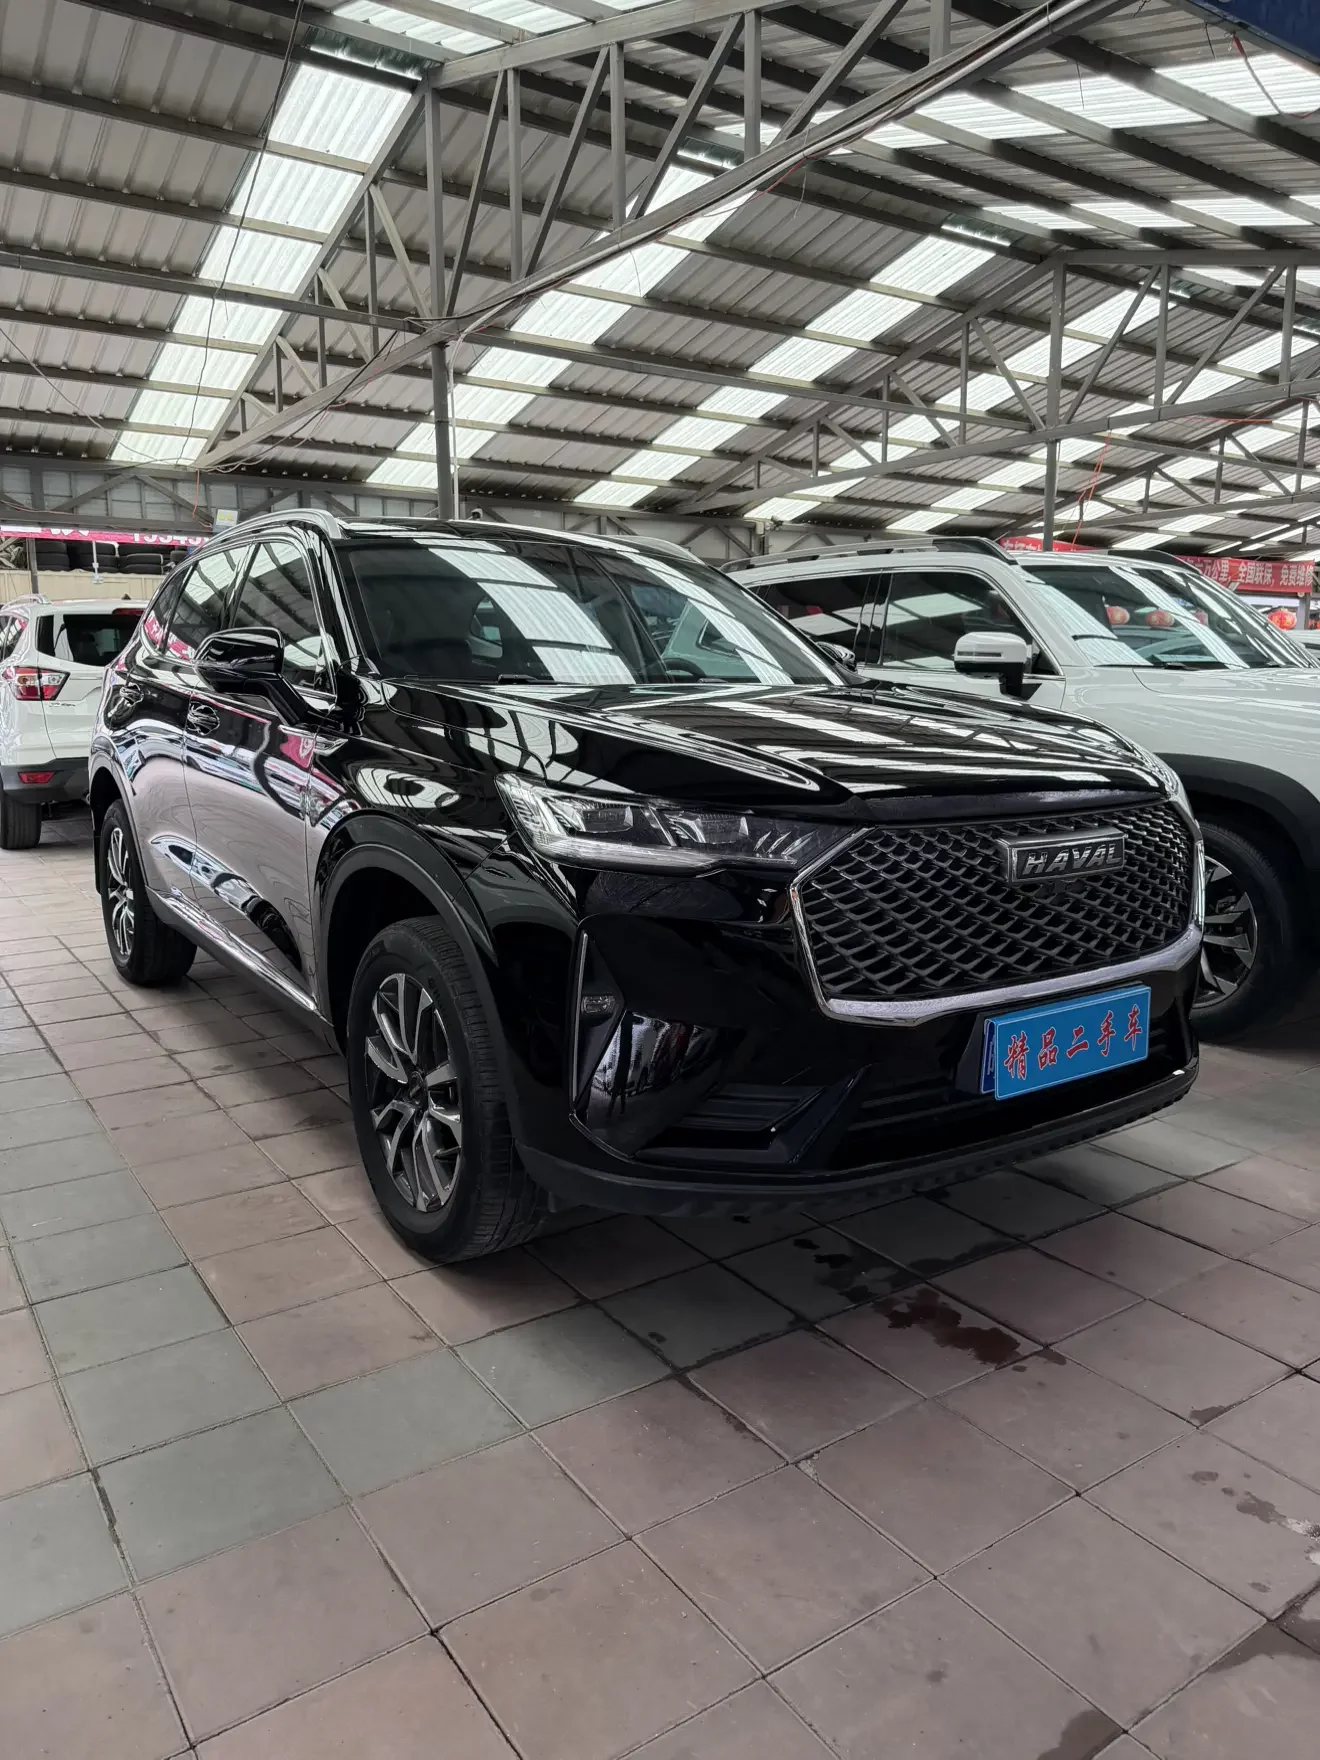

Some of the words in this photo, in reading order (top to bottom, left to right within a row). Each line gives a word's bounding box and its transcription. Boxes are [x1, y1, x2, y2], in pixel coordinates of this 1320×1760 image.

[1021, 843, 1122, 875] HAVAL
[1003, 1003, 1142, 1081] 精品二手车
